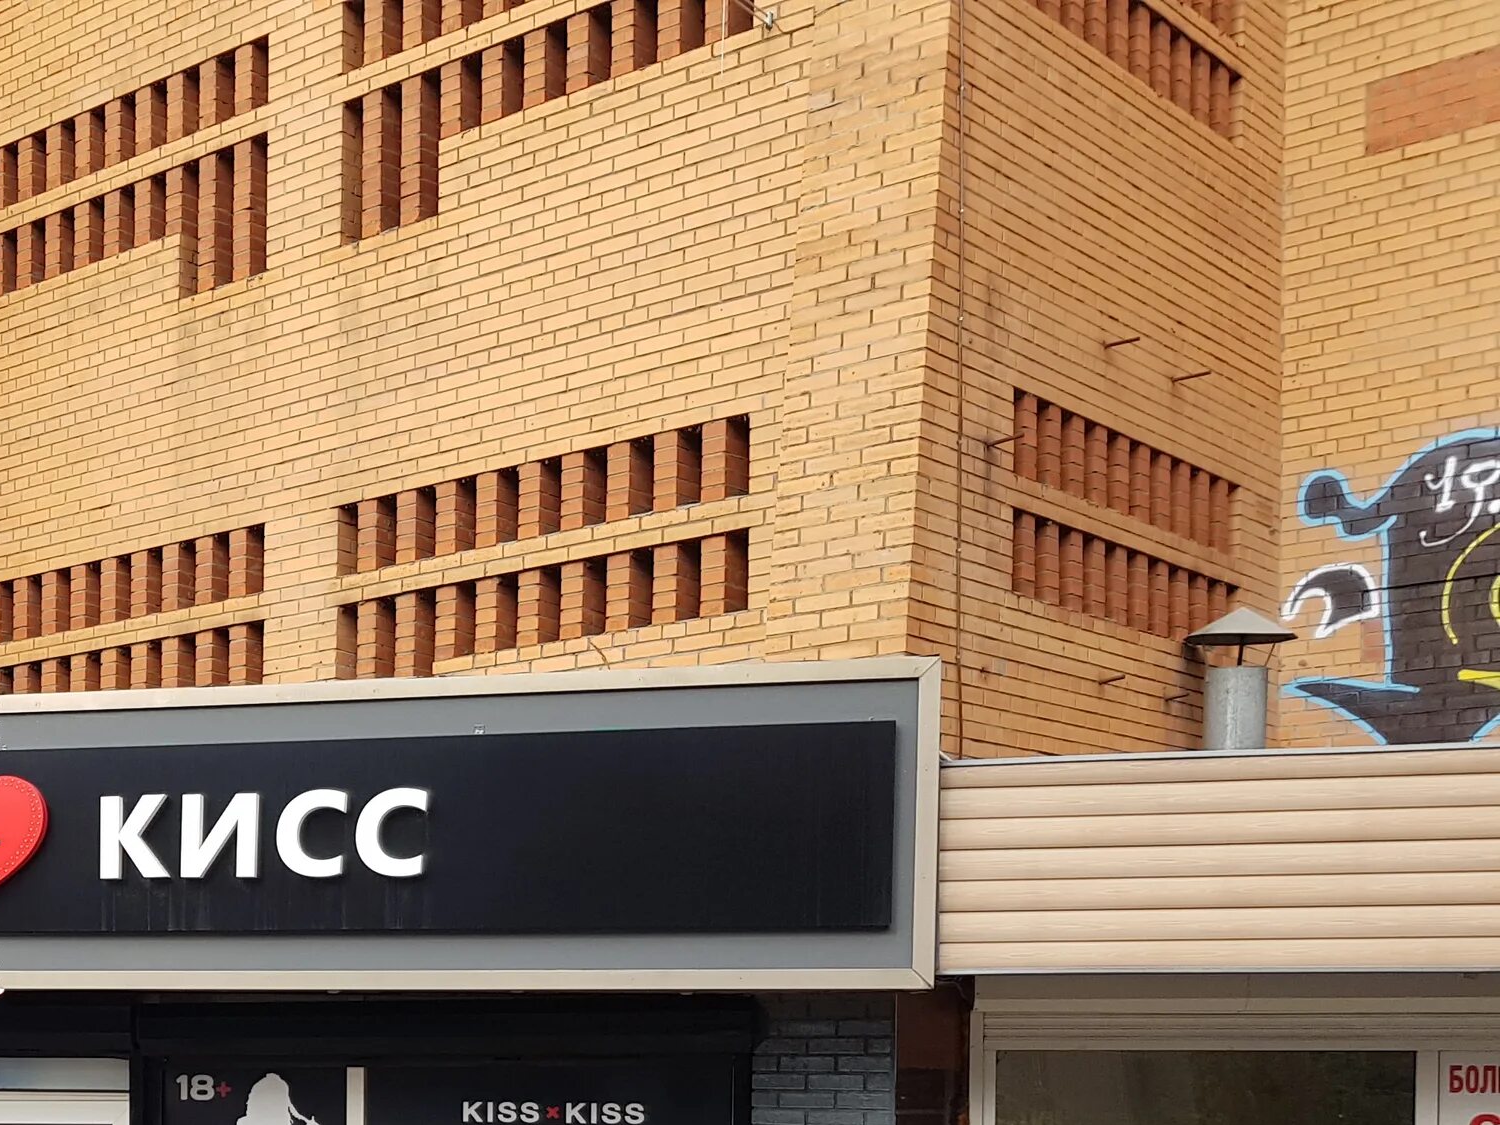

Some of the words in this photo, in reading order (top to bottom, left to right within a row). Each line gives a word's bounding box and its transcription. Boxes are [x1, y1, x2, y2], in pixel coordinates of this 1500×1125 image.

[100, 788, 430, 879] КИСС
[176, 1074, 231, 1101] 18+
[1449, 1065, 1500, 1094] БОЛ
